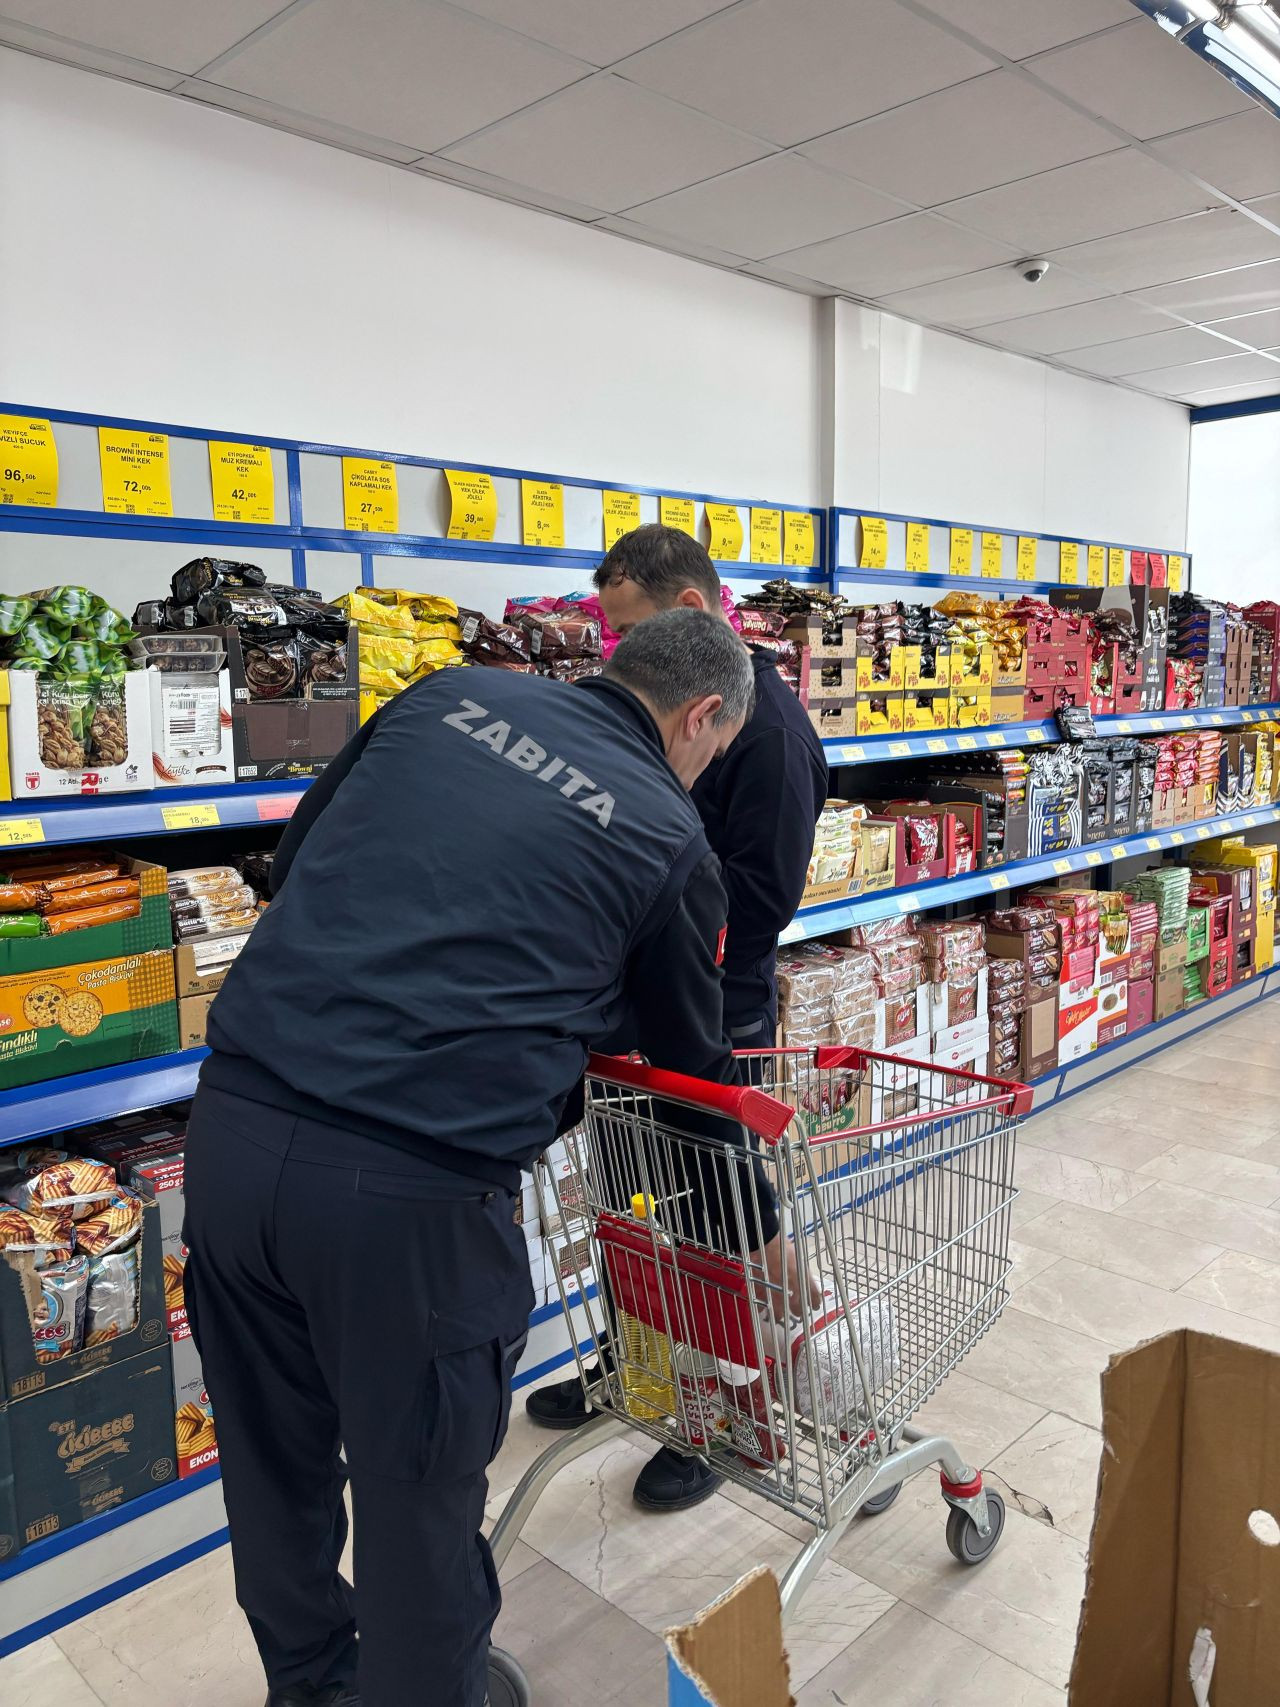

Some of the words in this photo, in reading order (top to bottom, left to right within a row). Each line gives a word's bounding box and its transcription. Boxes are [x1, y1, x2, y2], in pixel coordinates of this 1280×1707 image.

[19, 437, 46, 447] SUCUK
[137, 457, 151, 465] KEK
[236, 458, 263, 466] KREMALI
[350, 481, 381, 490] KAPLAMALI
[442, 699, 616, 829] ZABITA
[78, 956, 142, 986] Çokodamlalı
[87, 977, 107, 990] Pasta
[158, 1180, 174, 1190] 250
